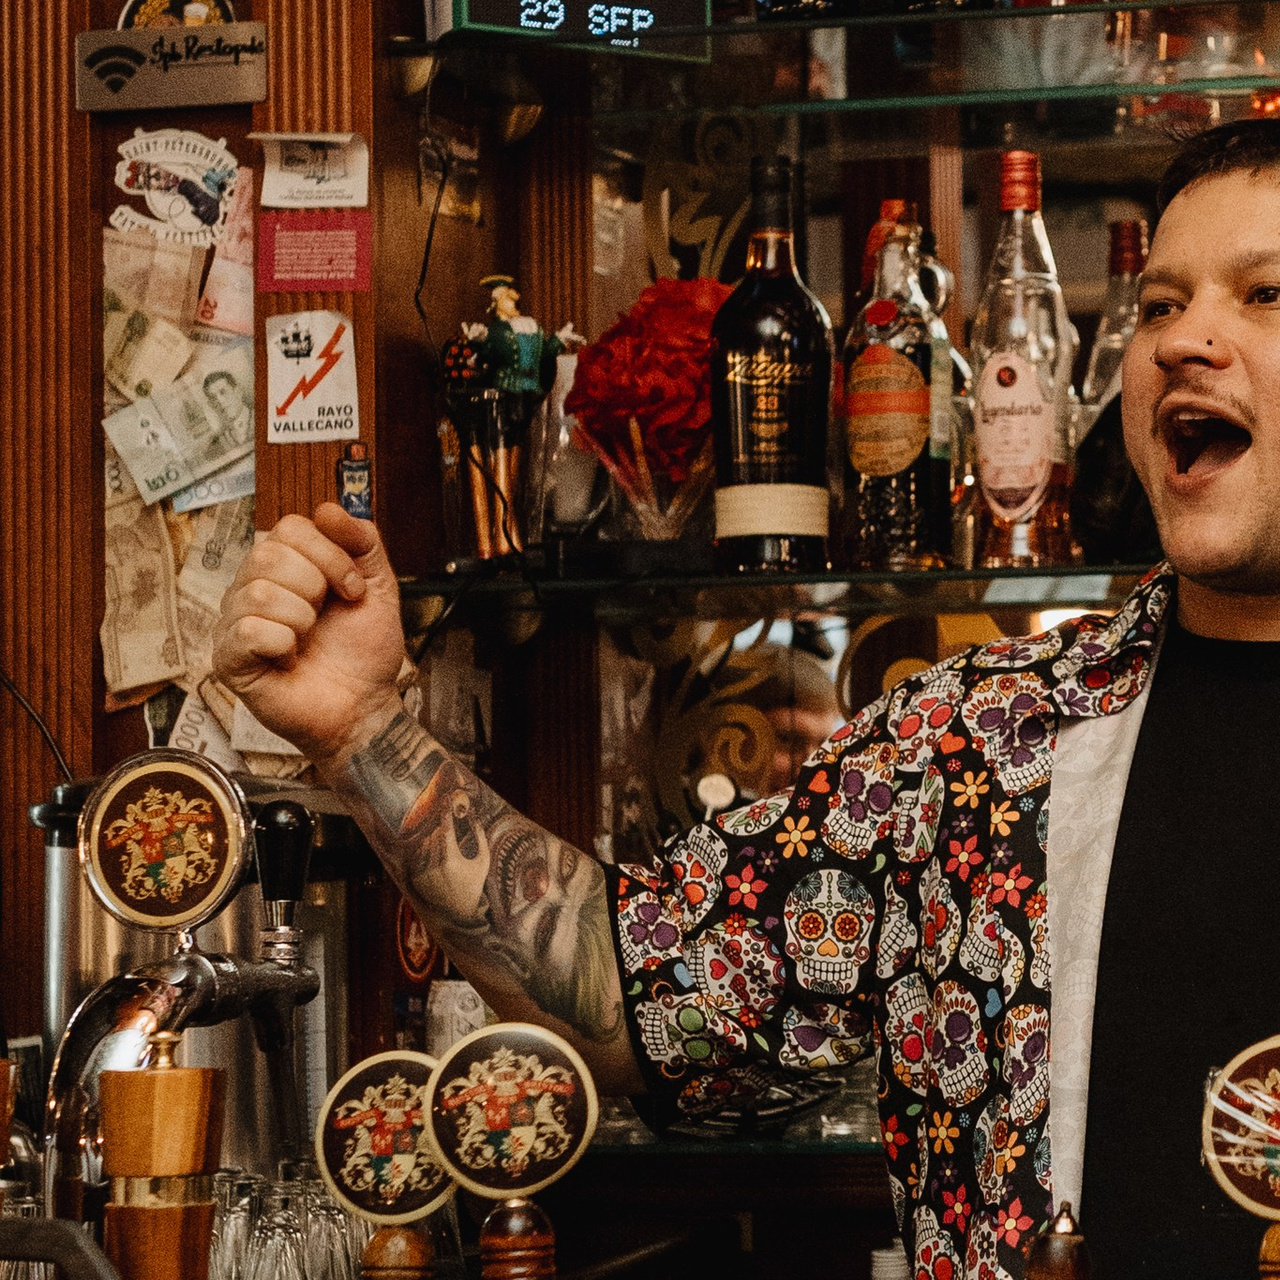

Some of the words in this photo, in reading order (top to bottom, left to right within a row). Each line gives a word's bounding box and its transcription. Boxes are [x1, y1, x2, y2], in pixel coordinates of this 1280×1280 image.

[587, 3, 655, 36] SEP
[317, 404, 354, 418] RAYO
[272, 417, 354, 434] VALLECANO
